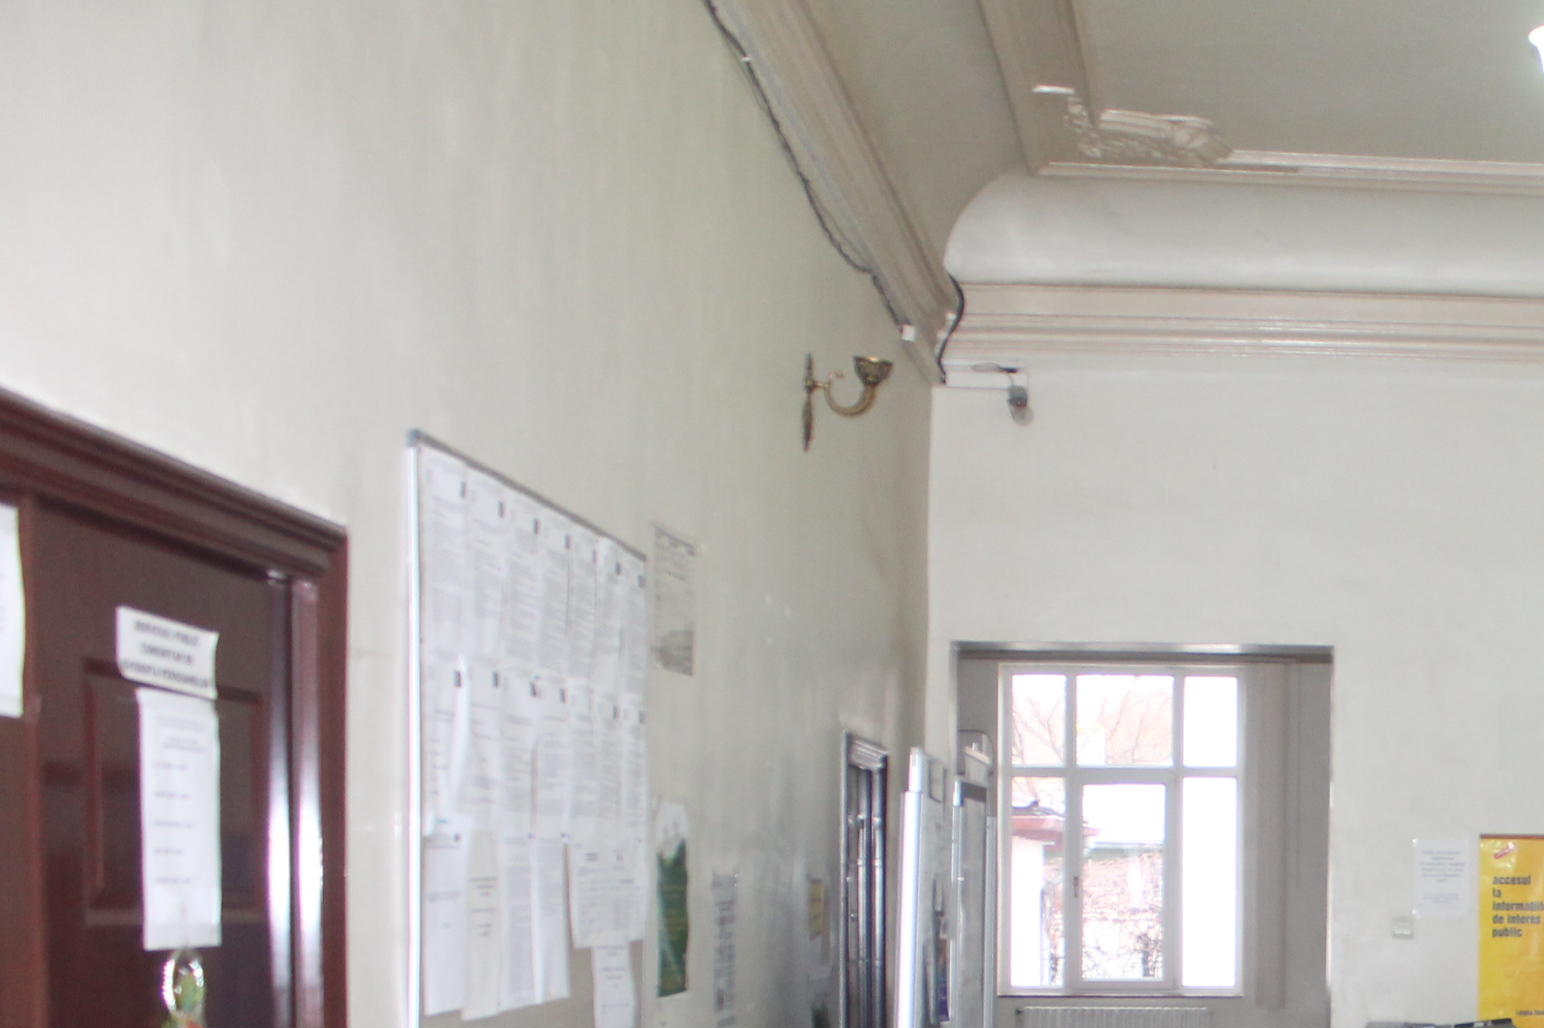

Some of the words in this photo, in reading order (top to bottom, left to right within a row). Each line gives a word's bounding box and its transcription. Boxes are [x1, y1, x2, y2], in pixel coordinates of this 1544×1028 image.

[1493, 875, 1531, 885] accesul
[1493, 888, 1502, 898] la
[1492, 914, 1504, 924] de
[1507, 914, 1541, 924] interes
[1492, 927, 1523, 938] public
